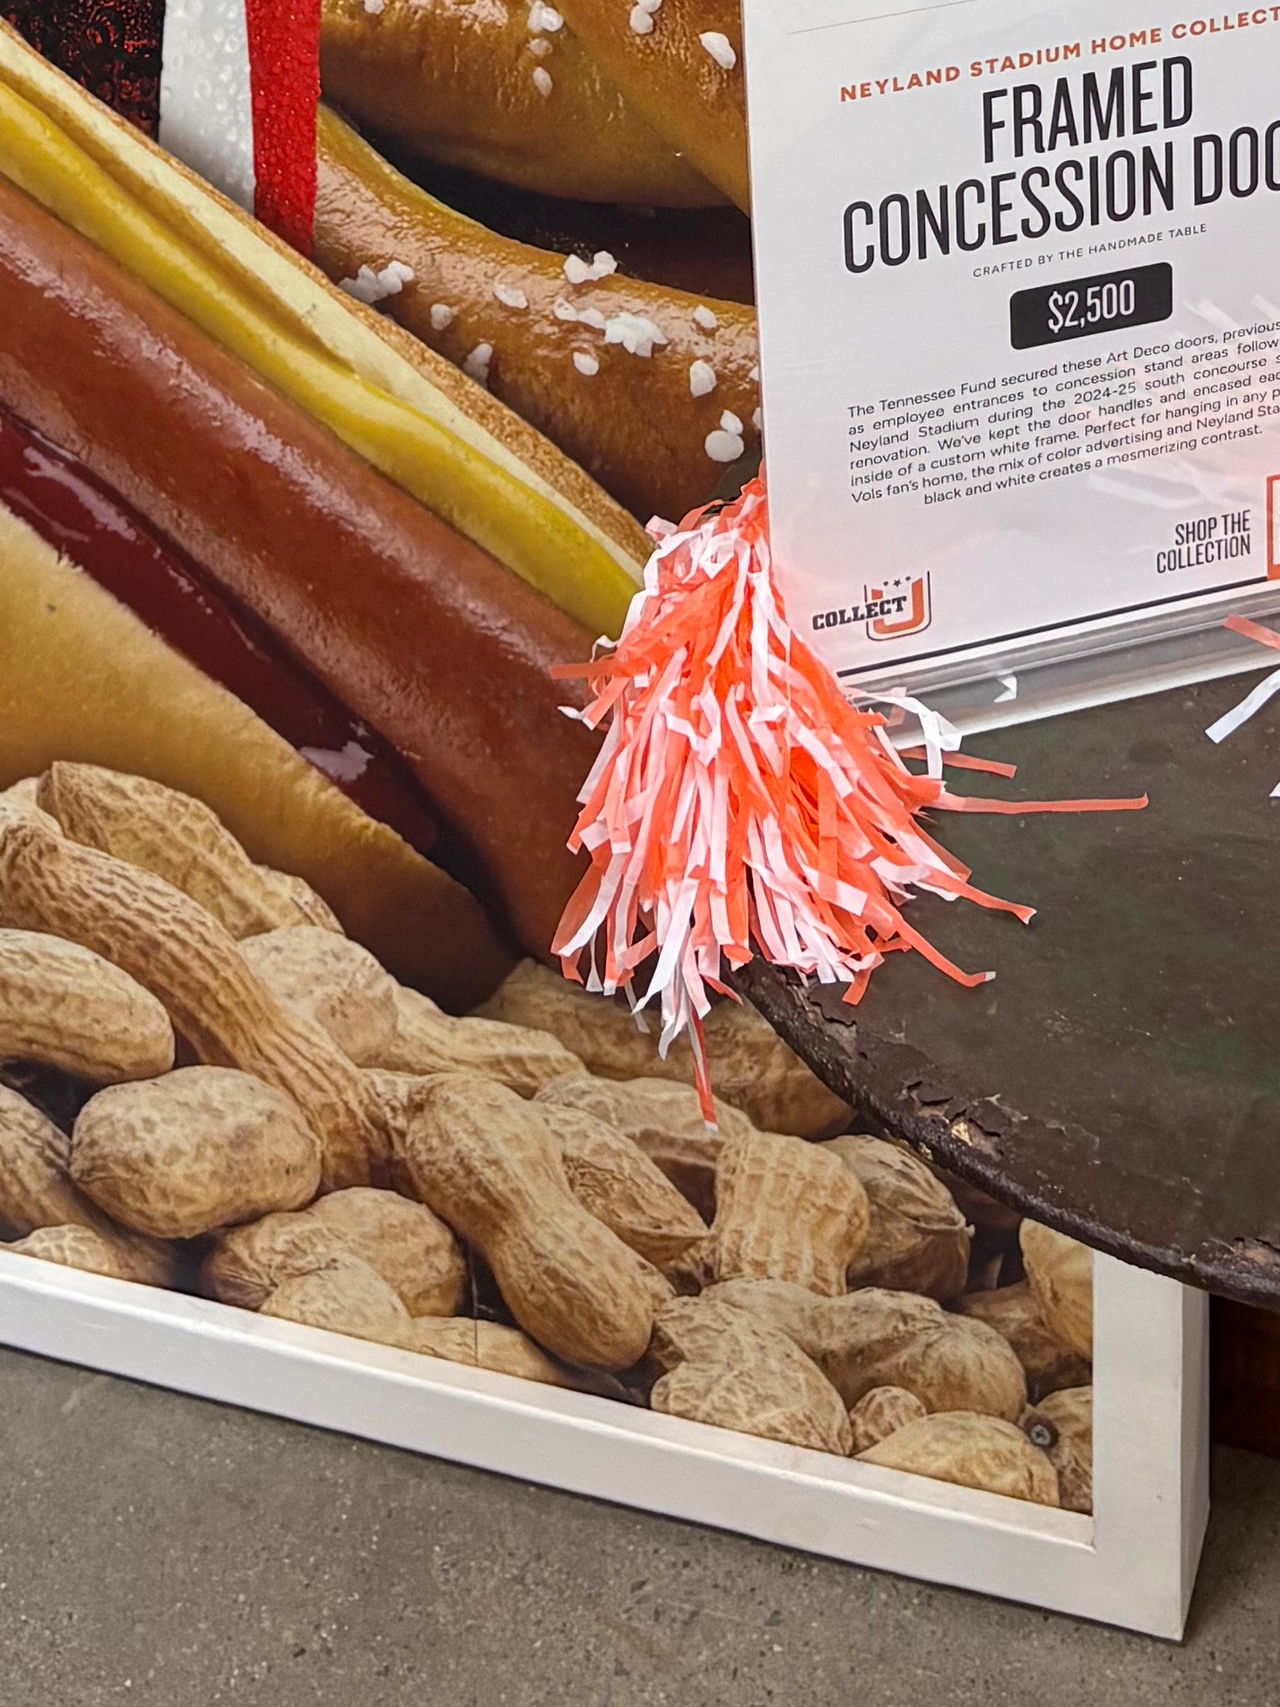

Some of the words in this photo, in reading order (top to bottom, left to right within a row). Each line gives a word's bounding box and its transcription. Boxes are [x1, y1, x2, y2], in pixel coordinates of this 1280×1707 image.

[839, 65, 961, 103] NEYLAND
[969, 41, 1082, 78] STADIUM
[1090, 26, 1162, 56] HOME
[982, 56, 1194, 163] FRAMED
[843, 142, 1174, 274] CONCESSION
[972, 258, 1033, 278] CRAFTED
[1038, 253, 1055, 266] BY
[1058, 247, 1084, 261] THE
[1088, 232, 1164, 254] HANDMADE
[1168, 224, 1208, 240] TABLE
[1047, 279, 1135, 334] $2,500
[848, 402, 874, 418] The
[878, 385, 955, 412] Tennessee
[960, 377, 996, 395] Fund
[1001, 364, 1057, 387] secured
[1062, 355, 1102, 374] these
[1106, 350, 1128, 365] Art
[1133, 341, 1170, 360] Deco
[1174, 331, 1218, 353] doors,
[848, 424, 864, 436] as
[872, 404, 945, 433] employee
[952, 389, 1024, 414] entrances
[1032, 384, 1048, 397] to
[1055, 365, 1135, 393] concession
[1144, 355, 1182, 374] stand
[1191, 348, 1228, 365] areas
[849, 429, 908, 455] Neyland
[918, 414, 979, 438] Stadium
[987, 403, 1033, 426] during
[1042, 396, 1065, 412] the
[1073, 382, 1136, 406] 2024-25
[1144, 371, 1184, 391] south
[1193, 357, 1267, 381] concourse
[849, 442, 930, 469] renovation.
[937, 431, 981, 451] We've
[988, 423, 1020, 443] kept
[1027, 416, 1051, 432] the
[1057, 408, 1091, 426] door
[1098, 395, 1152, 417] handles
[1159, 388, 1185, 404] and
[1193, 374, 1251, 397] encased
[850, 467, 893, 486] inside
[897, 462, 912, 477] of
[917, 462, 926, 472] a
[930, 448, 985, 470] custom
[989, 438, 1029, 457] white
[1034, 427, 1079, 448] frame.
[1084, 416, 1135, 437] Perfect
[1141, 410, 1161, 425] for
[1165, 398, 1221, 423] hanging
[1226, 394, 1238, 407] in
[1242, 390, 1267, 407] any
[851, 486, 883, 504] Vols
[886, 478, 918, 496] fan's
[922, 468, 967, 490] home,
[971, 462, 995, 478] the
[998, 456, 1024, 472] mix
[1027, 452, 1043, 466] of
[1046, 444, 1082, 462] color
[1085, 426, 1162, 456] advertising
[1166, 420, 1192, 437] and
[1196, 407, 1253, 433] Neyland
[924, 486, 961, 505] black
[965, 479, 991, 496] and
[995, 470, 1035, 489] white
[1038, 459, 1091, 480] creates
[1094, 458, 1103, 468] a
[1107, 436, 1197, 468] mesmerizing
[1201, 423, 1262, 446] contrast.
[1156, 531, 1250, 575] COLLECTION
[1174, 515, 1217, 547] SHOP
[1220, 508, 1251, 537] THE
[811, 594, 908, 632] COLLECT
